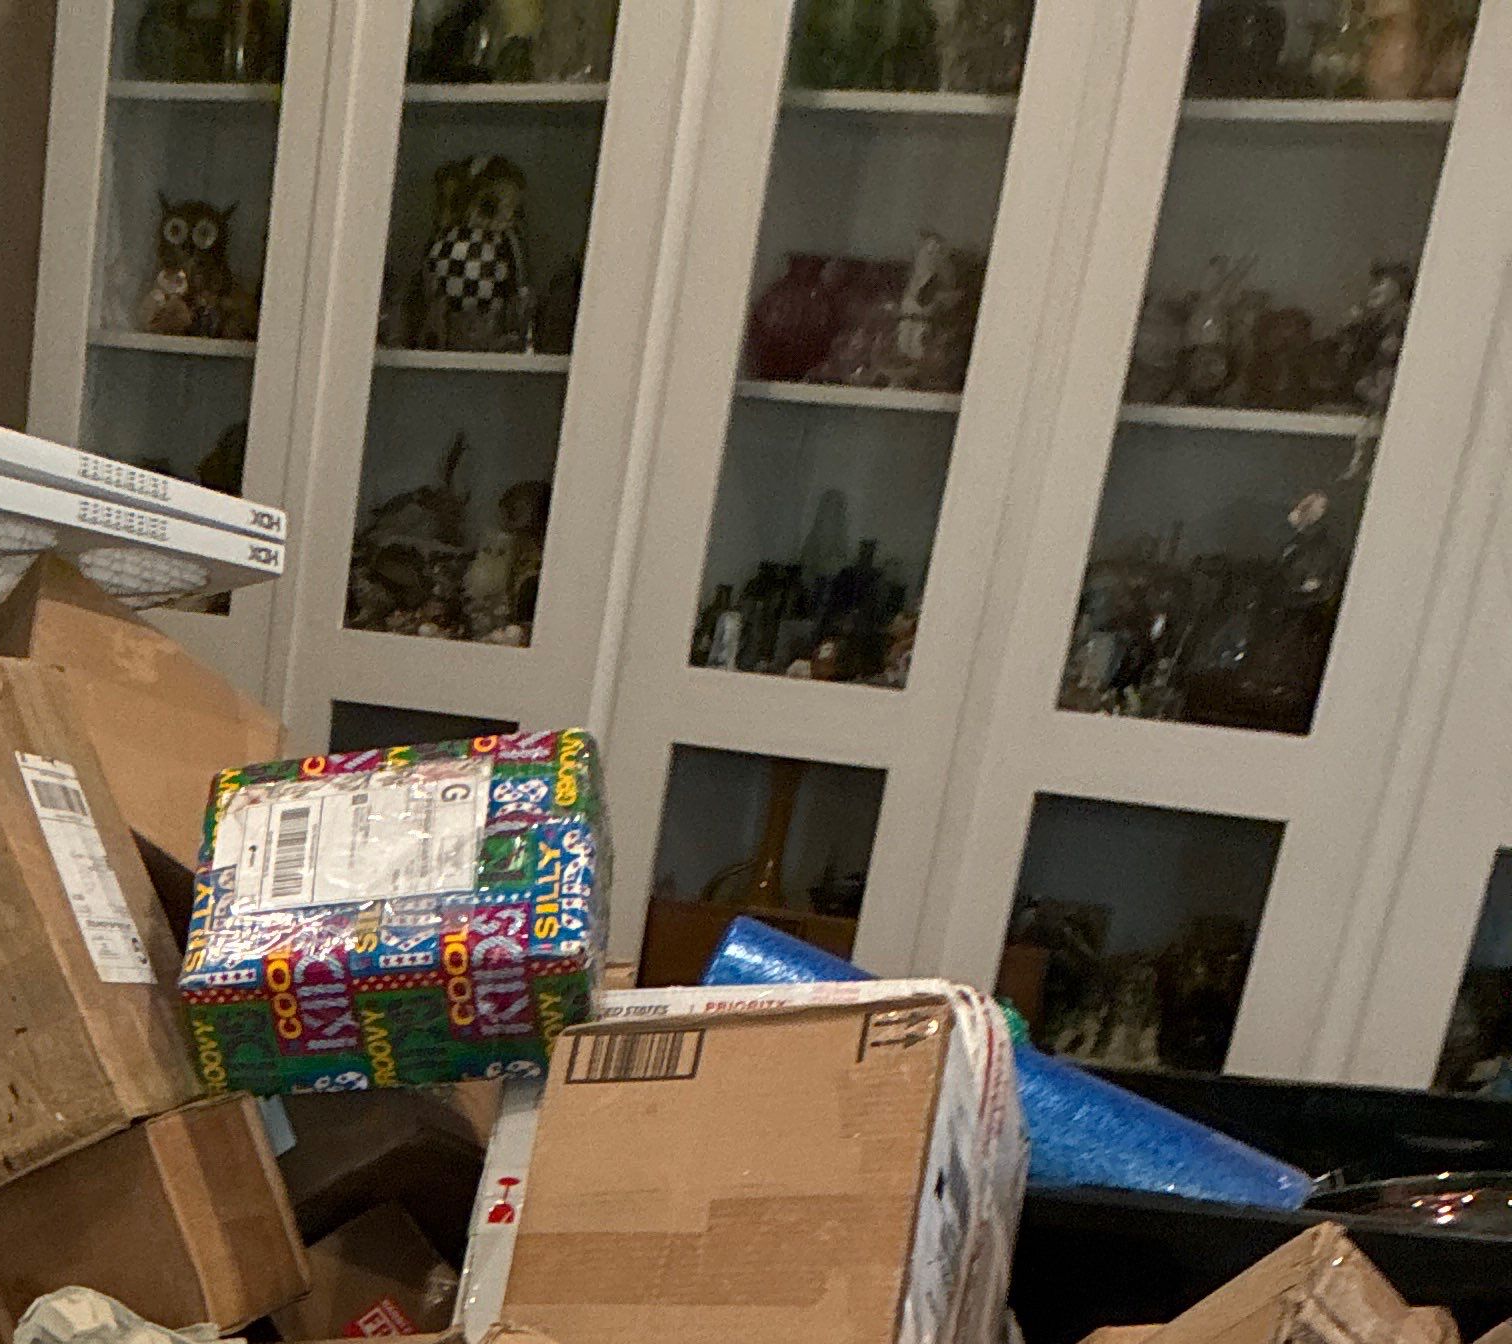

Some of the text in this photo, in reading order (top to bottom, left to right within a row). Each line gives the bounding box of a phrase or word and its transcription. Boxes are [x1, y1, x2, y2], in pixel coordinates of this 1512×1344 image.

[441, 783, 471, 803] G
[534, 842, 561, 939] SILLY
[443, 922, 476, 1026] COOL
[471, 907, 534, 1037] KIDS
